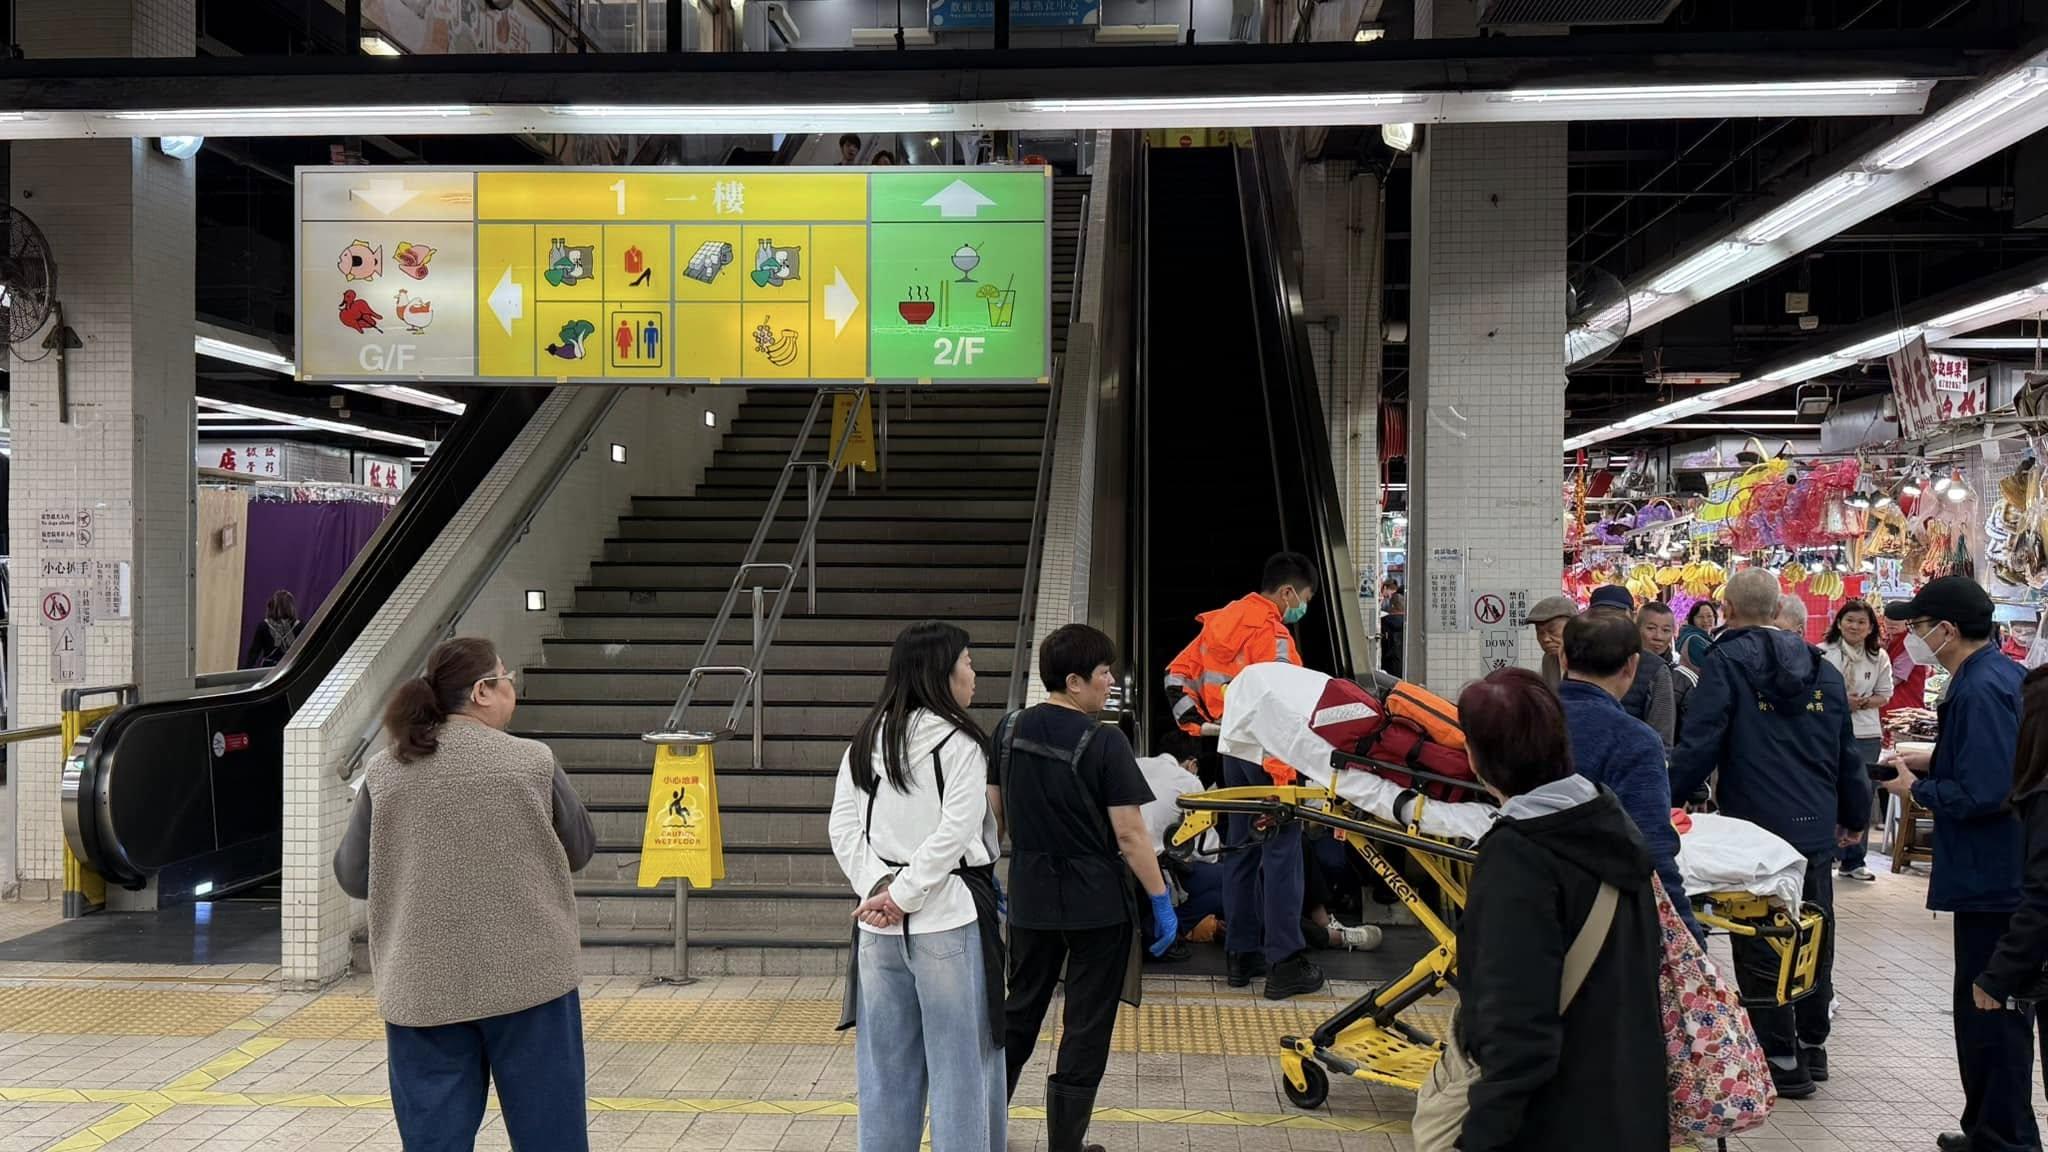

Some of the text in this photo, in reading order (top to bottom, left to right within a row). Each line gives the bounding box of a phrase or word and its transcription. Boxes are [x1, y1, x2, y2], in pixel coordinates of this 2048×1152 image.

[609, 181, 626, 215] 1
[359, 342, 415, 371] G/F
[933, 337, 985, 366] 2/F
[60, 635, 75, 652] 上
[1485, 639, 1515, 648] DOWN
[62, 670, 75, 679] UP
